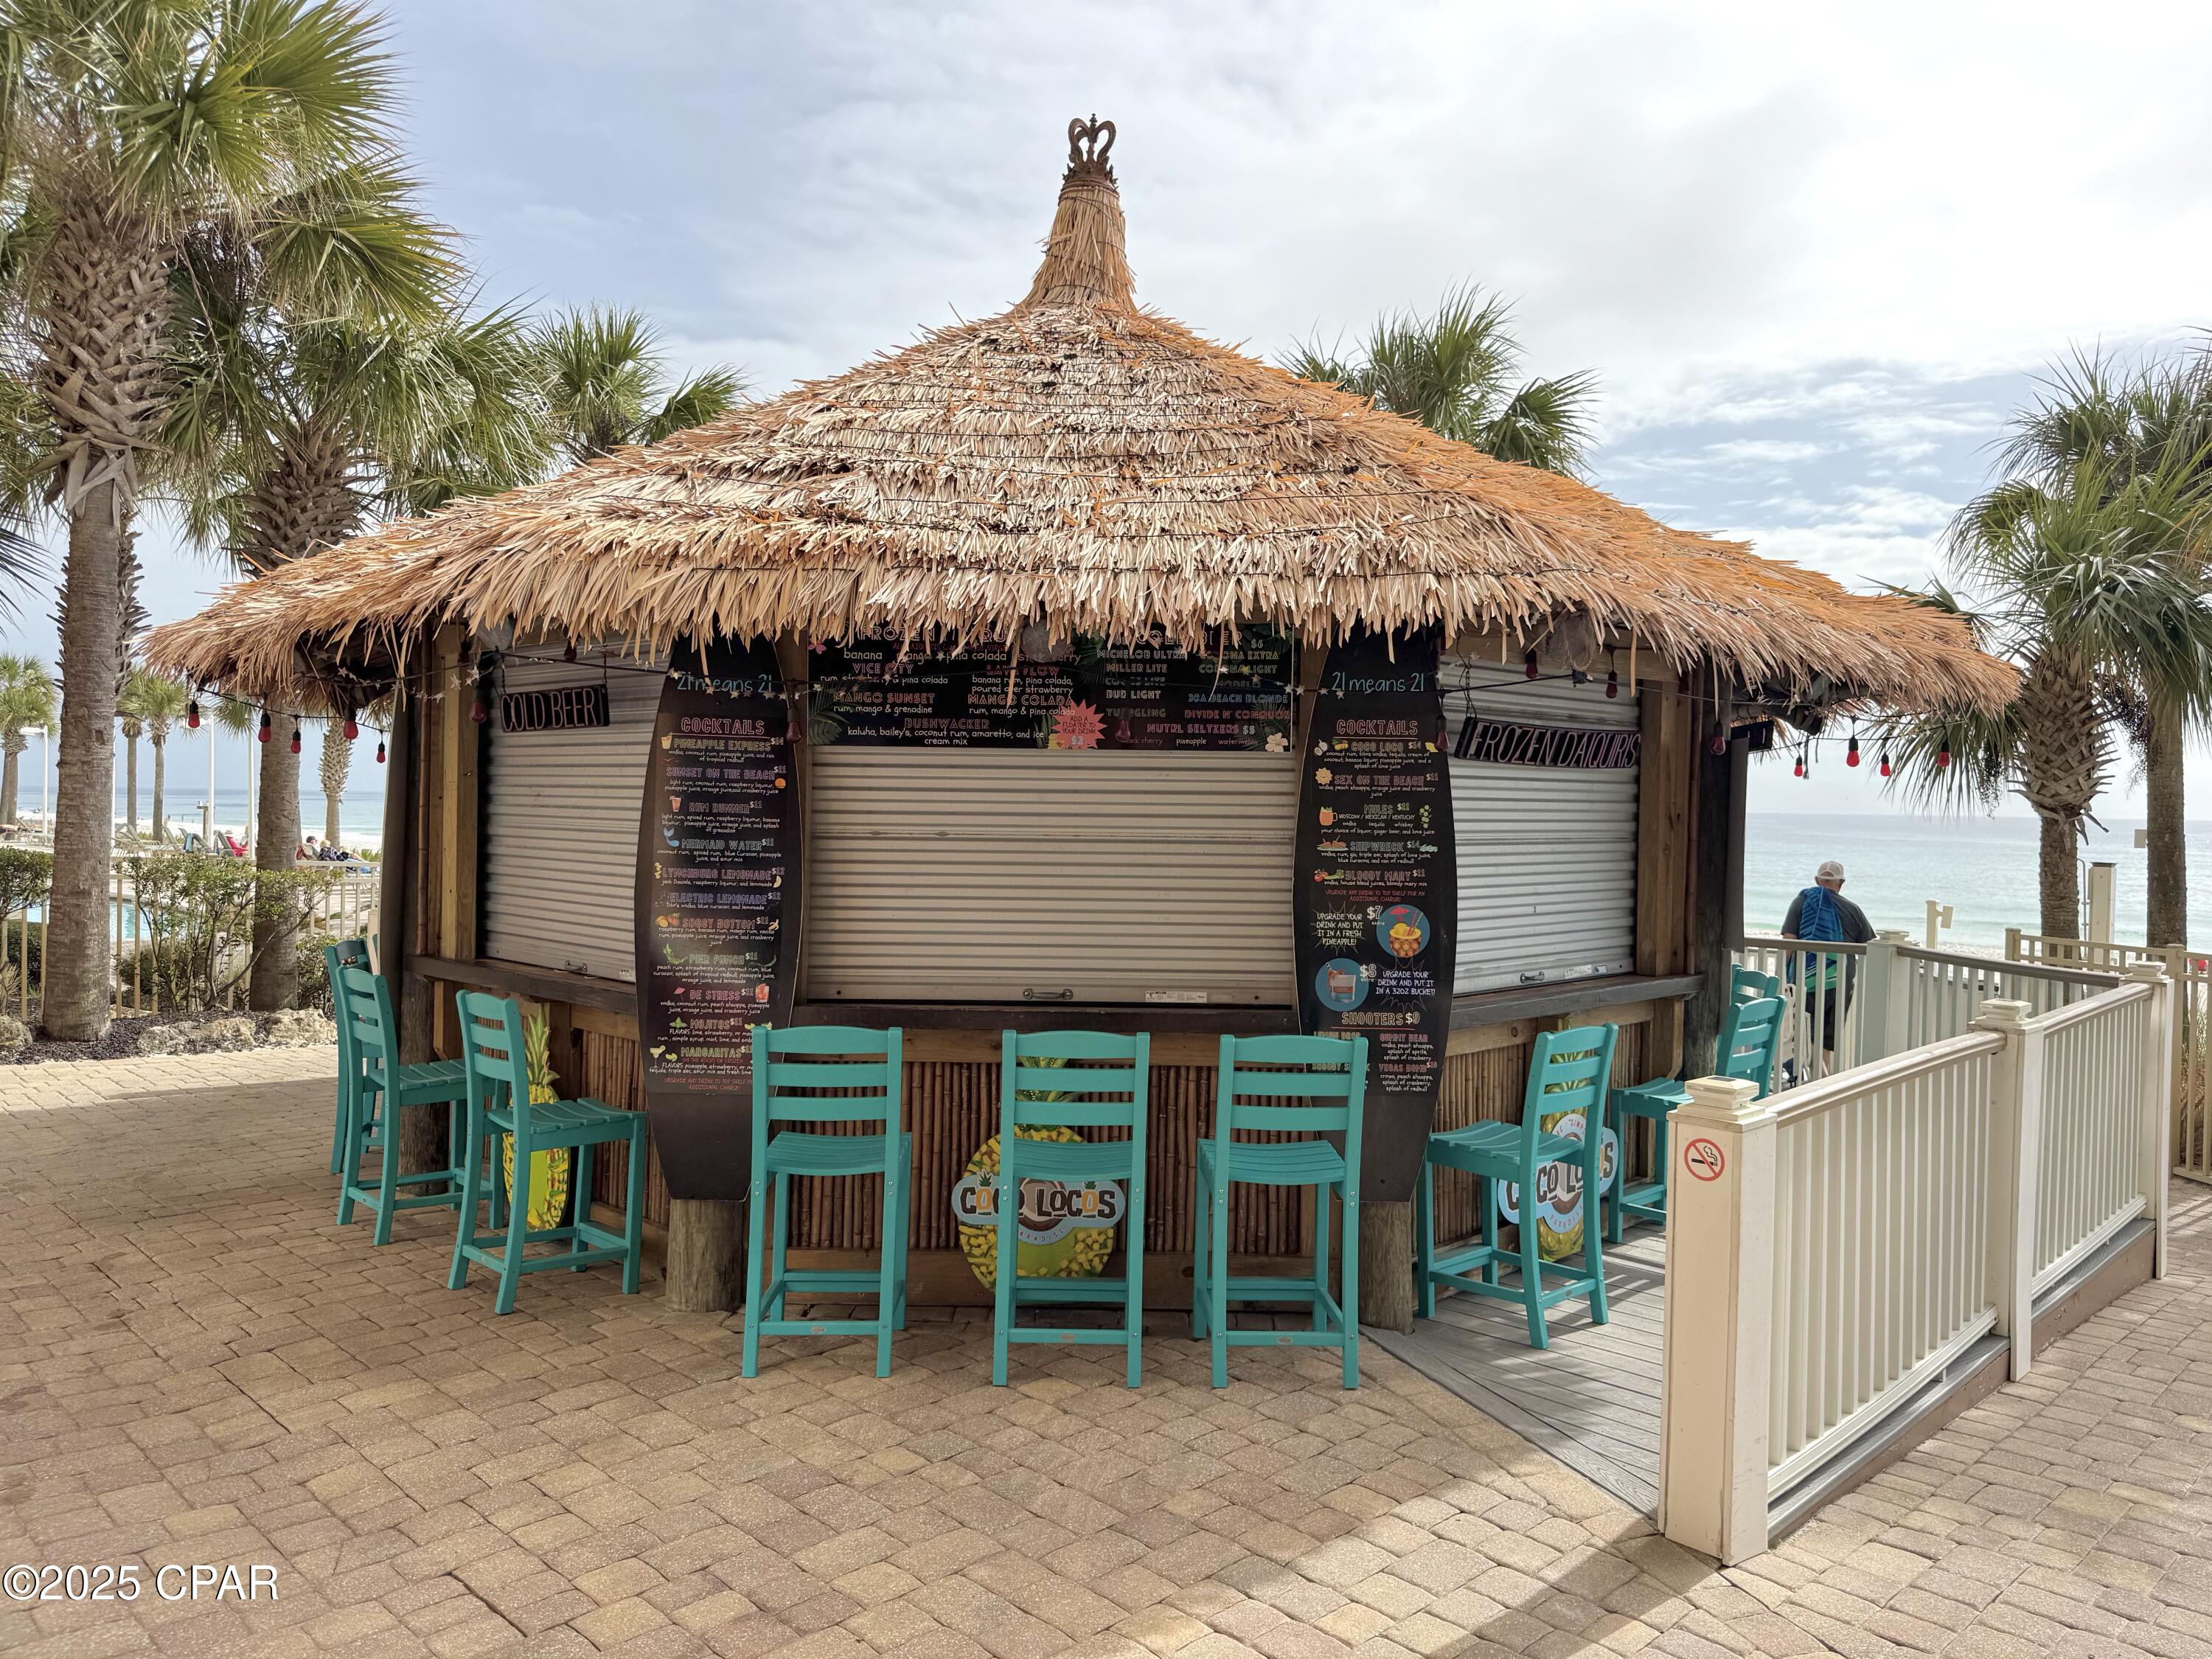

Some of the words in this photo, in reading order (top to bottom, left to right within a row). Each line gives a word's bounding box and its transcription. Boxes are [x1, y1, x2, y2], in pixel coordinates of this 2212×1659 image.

[1251, 639, 1264, 648] $6
[844, 647, 882, 659] banana
[973, 650, 1006, 661] colada
[1097, 650, 1150, 658] MICHELOB
[1154, 650, 1186, 659] ULTRA
[852, 663, 881, 674] VICE
[1107, 664, 1143, 672] MILLER
[1147, 664, 1167, 672] LITE
[973, 674, 1001, 684] banana
[1026, 677, 1042, 686] pina
[1046, 675, 1073, 685] colada,
[1332, 672, 1345, 690] 21
[1349, 679, 1405, 692] means
[1411, 673, 1423, 692] 21
[973, 685, 1001, 695] poured
[1025, 685, 1073, 696] strawberry
[1107, 690, 1126, 699] BUD
[1131, 690, 1161, 699] LIGHT
[833, 692, 883, 703] MANGO
[887, 693, 935, 703] SUNSET
[967, 695, 1018, 705] MANGO
[1021, 695, 1073, 706] COLADA
[1209, 694, 1242, 703] BEACH
[1245, 695, 1287, 703] BLONDE
[501, 693, 545, 731] COLD
[551, 688, 597, 728] BEER
[856, 707, 883, 715] mango
[894, 705, 932, 716] grenadine
[992, 707, 1018, 717] mango
[1030, 708, 1046, 717] pina
[1049, 706, 1074, 715] colada
[1185, 710, 1219, 718] DIVIDE
[681, 717, 765, 734] COCKTAILS
[904, 718, 990, 729] BUSHWACKER
[1147, 724, 1184, 734] NUTRL
[1188, 724, 1239, 734] SELTZERS
[1243, 726, 1255, 734] $5
[1337, 720, 1418, 735] COCKTAILS
[848, 727, 877, 737] kaluha,
[880, 728, 912, 738] bailey's,
[915, 728, 947, 737] coconut
[972, 730, 1014, 739] amaretto,
[1016, 729, 1030, 738] and
[1033, 730, 1044, 738] ice
[674, 739, 725, 749] PINEAPPLE
[728, 741, 771, 751] EXPRESS
[1071, 736, 1083, 745] $2
[1176, 737, 1206, 746] pineapple
[1467, 722, 1562, 765] FROZEN
[1557, 730, 1640, 768] DAIQUIRIS
[1352, 742, 1376, 751] COCO
[1380, 742, 1403, 752] LOCO
[1408, 741, 1422, 749] $14
[667, 767, 702, 777] SUNSET
[706, 768, 720, 778] ON
[724, 769, 740, 779] THE
[744, 770, 774, 779] BEACH
[1335, 775, 1352, 785] SEX
[1357, 776, 1369, 785] ON
[1374, 776, 1390, 785] THE
[1394, 776, 1424, 786] BEACH
[689, 803, 709, 812] RUM
[712, 803, 749, 813] RUNNER
[1364, 804, 1393, 814] MULES
[682, 839, 724, 849] MERMAID
[729, 840, 762, 850] WATER
[1350, 841, 1404, 852] SHIPWRECK
[662, 868, 717, 878] LYNCHBURG
[722, 869, 771, 880] LEMONADE
[1345, 871, 1380, 880] BLOODY
[1385, 872, 1411, 881] MARY
[670, 893, 714, 903] ELECTRIC
[717, 894, 767, 904] LEMONADE
[1367, 905, 1382, 920] $7
[683, 919, 714, 928] SOGGY
[717, 919, 755, 929] BOTTOM
[689, 954, 709, 964] PIER
[714, 954, 744, 964] PUNCH
[1360, 964, 1377, 978] $8
[690, 990, 702, 999] DE
[706, 991, 740, 1001] STRESS
[690, 1019, 731, 1029] MOJITOS
[1342, 1012, 1403, 1025] SHOOTERS
[1405, 1012, 1419, 1024] $9
[1408, 1034, 1428, 1042] BEAR
[681, 1047, 742, 1058] MARGARITAS
[1379, 1063, 1403, 1072] VEGAS
[1406, 1064, 1427, 1073] BOMB
[1036, 1189, 1116, 1219] LOCOS
